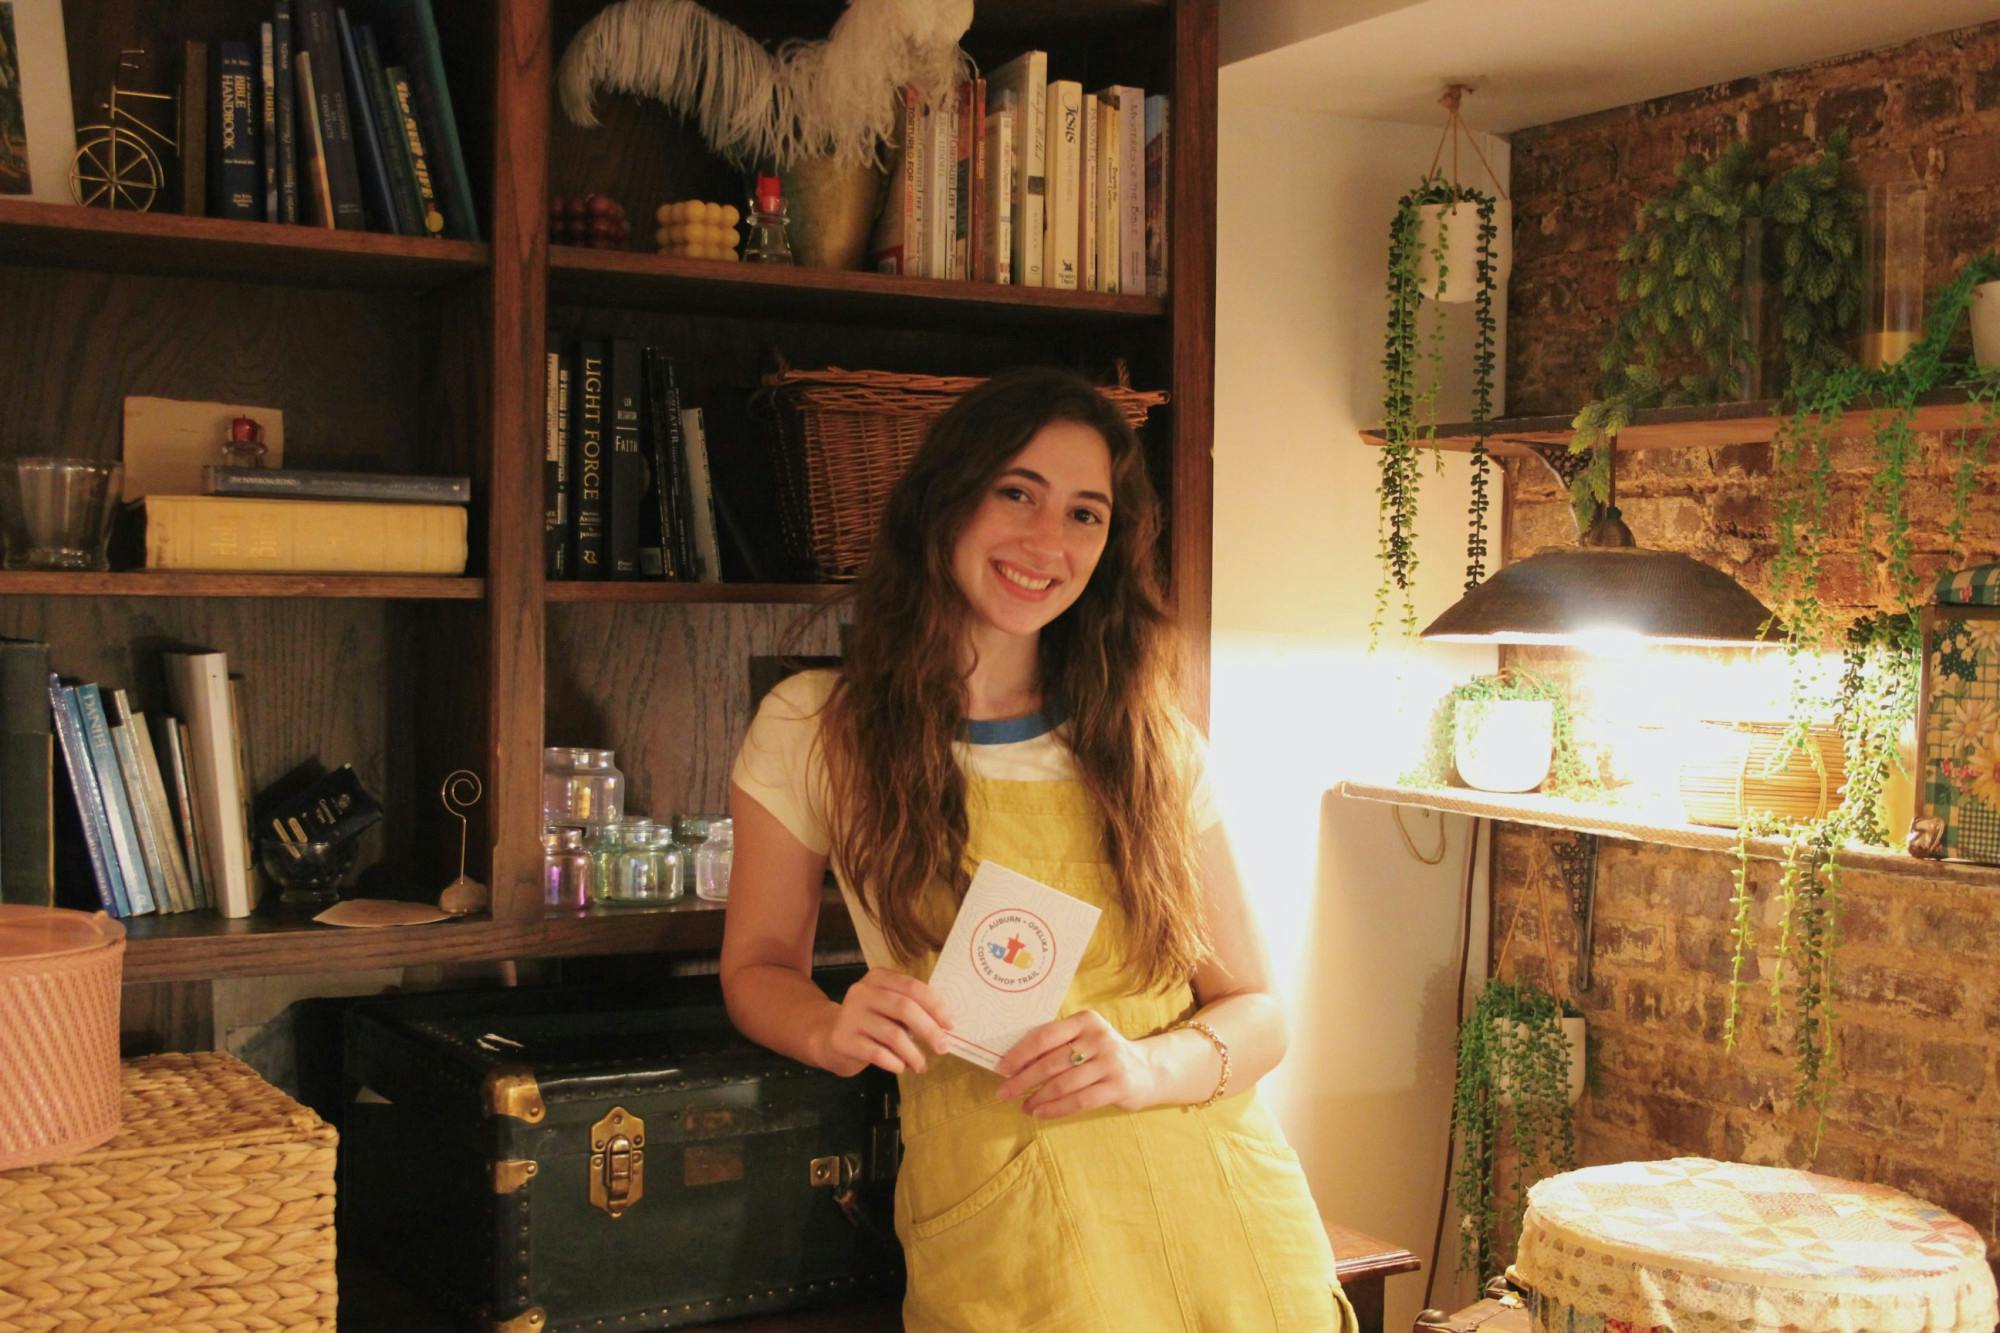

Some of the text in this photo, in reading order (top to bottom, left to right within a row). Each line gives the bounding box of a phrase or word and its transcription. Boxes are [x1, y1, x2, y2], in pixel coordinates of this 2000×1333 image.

[235, 75, 247, 108] BIBLE
[222, 74, 235, 150] HANDBOOK
[906, 106, 915, 160] TORTURED
[906, 161, 915, 182] FOR
[1130, 163, 1139, 178] OF
[1130, 183, 1139, 201] THE
[584, 357, 602, 424] LIGHT
[615, 435, 638, 452] FAITH
[583, 428, 601, 500] FORCE
[988, 916, 1048, 953] AUBURN OPELIKA
[977, 946, 1039, 985] COFFEE SHOP TRAIL
